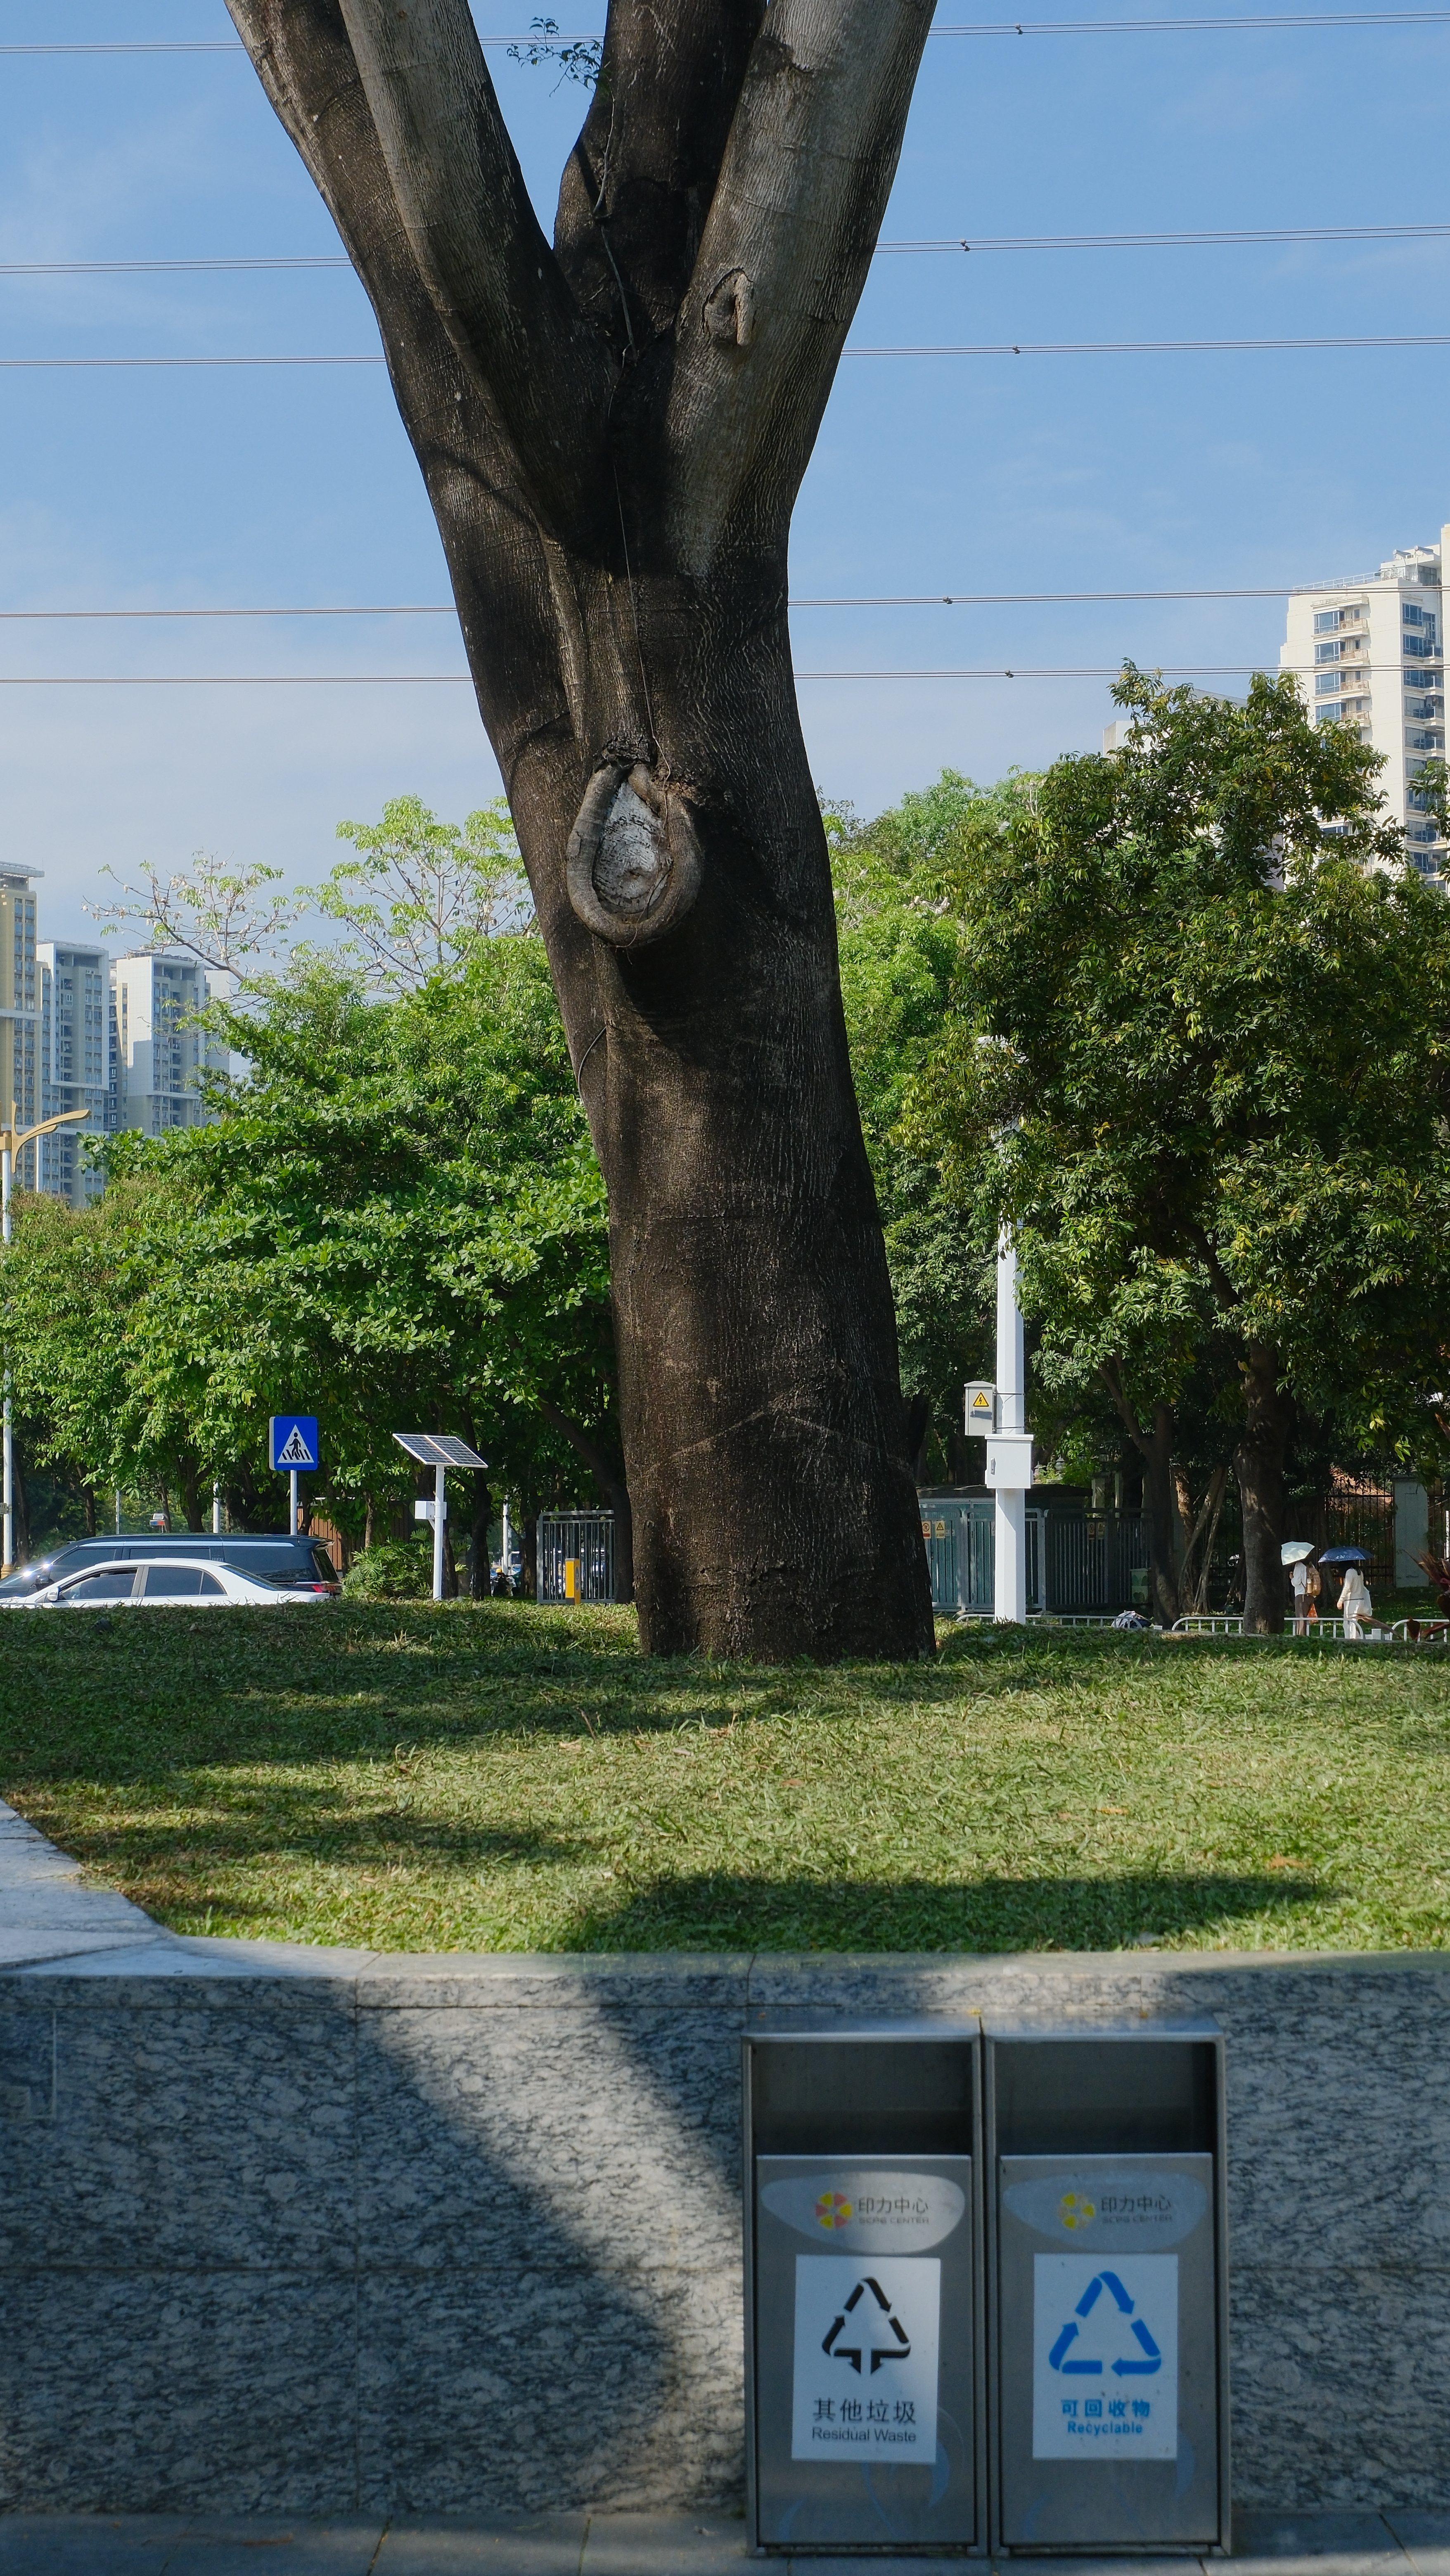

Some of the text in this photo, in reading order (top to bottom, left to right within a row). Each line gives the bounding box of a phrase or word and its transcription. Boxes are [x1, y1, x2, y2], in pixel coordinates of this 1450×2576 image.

[858, 2196, 929, 2214] 印力中心
[1101, 2195, 1171, 2213] 印力中心
[813, 2397, 916, 2424] 其他垃圾
[1061, 2398, 1150, 2417] 可回收物
[812, 2426, 916, 2442] Residual Waste
[1067, 2421, 1142, 2436] Recyclable
